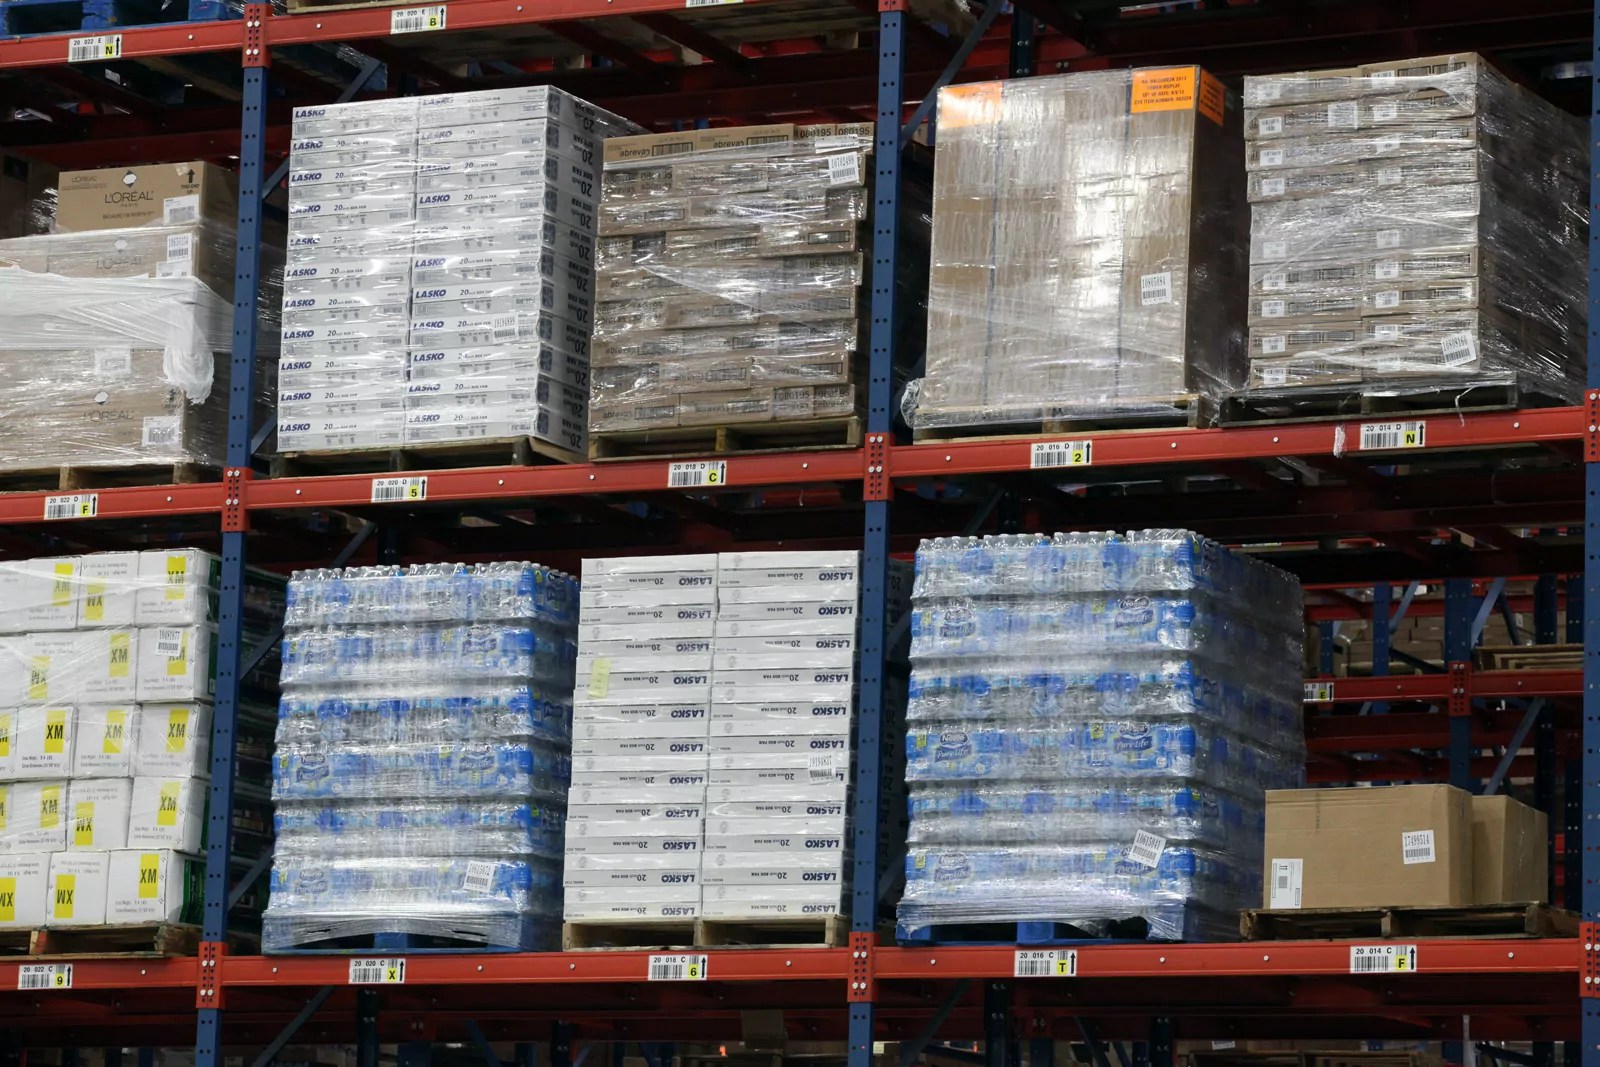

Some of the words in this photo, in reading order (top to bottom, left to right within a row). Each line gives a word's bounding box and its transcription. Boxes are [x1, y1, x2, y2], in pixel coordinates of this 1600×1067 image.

[430, 18, 437, 26] B
[105, 46, 113, 55] N
[295, 109, 325, 118] LASKO
[800, 128, 832, 137] 080195
[838, 127, 870, 136] 080195
[293, 141, 323, 150] LASKO
[292, 173, 322, 182] LASKO
[419, 195, 450, 204] LASKO
[290, 205, 321, 214] ASKO
[415, 258, 446, 268] LASKO
[287, 268, 317, 277] LASKO
[416, 289, 446, 298] LASKO
[285, 299, 315, 308] LASKO
[284, 330, 314, 339] LASKO
[414, 353, 444, 362] LASKO
[281, 361, 311, 370] LASKO
[281, 392, 311, 402] LASKO
[280, 423, 310, 432] LASKO
[1406, 434, 1415, 443] N
[1074, 454, 1081, 462] 2
[709, 473, 716, 482] C
[411, 489, 417, 497] 5
[83, 505, 88, 514] F
[819, 572, 853, 580] LASKO
[679, 577, 712, 585] LASKO
[87, 595, 103, 607] XM
[678, 610, 711, 619] LASKO
[818, 607, 852, 615] LASKO
[676, 643, 709, 652] LASKO
[816, 640, 850, 648] LASKO
[111, 648, 128, 663] XM
[674, 676, 707, 684] LASKO
[814, 674, 848, 682] LASKO
[671, 710, 704, 718] LASKO
[812, 707, 846, 715] LASKO
[47, 725, 63, 739] XM
[105, 724, 122, 738] XM
[168, 723, 185, 738] XM
[670, 744, 703, 752] LASKO
[810, 740, 844, 748] LASKO
[42, 800, 58, 814] XM
[160, 797, 176, 811] XM
[666, 809, 699, 817] LASKO
[807, 806, 841, 814] LASKO
[77, 817, 92, 832] XM
[663, 841, 696, 850] LASKO
[805, 840, 839, 848] LASKO
[140, 869, 157, 884] XM
[662, 874, 695, 882] LASKO
[802, 872, 836, 881] LASKO
[57, 890, 73, 904] XM
[662, 907, 695, 915] LASKO
[802, 905, 836, 913] LASKO
[1059, 963, 1066, 972] T
[1398, 958, 1405, 968] F
[389, 971, 395, 980] X
[690, 968, 697, 976] 6
[57, 977, 63, 985] 9
